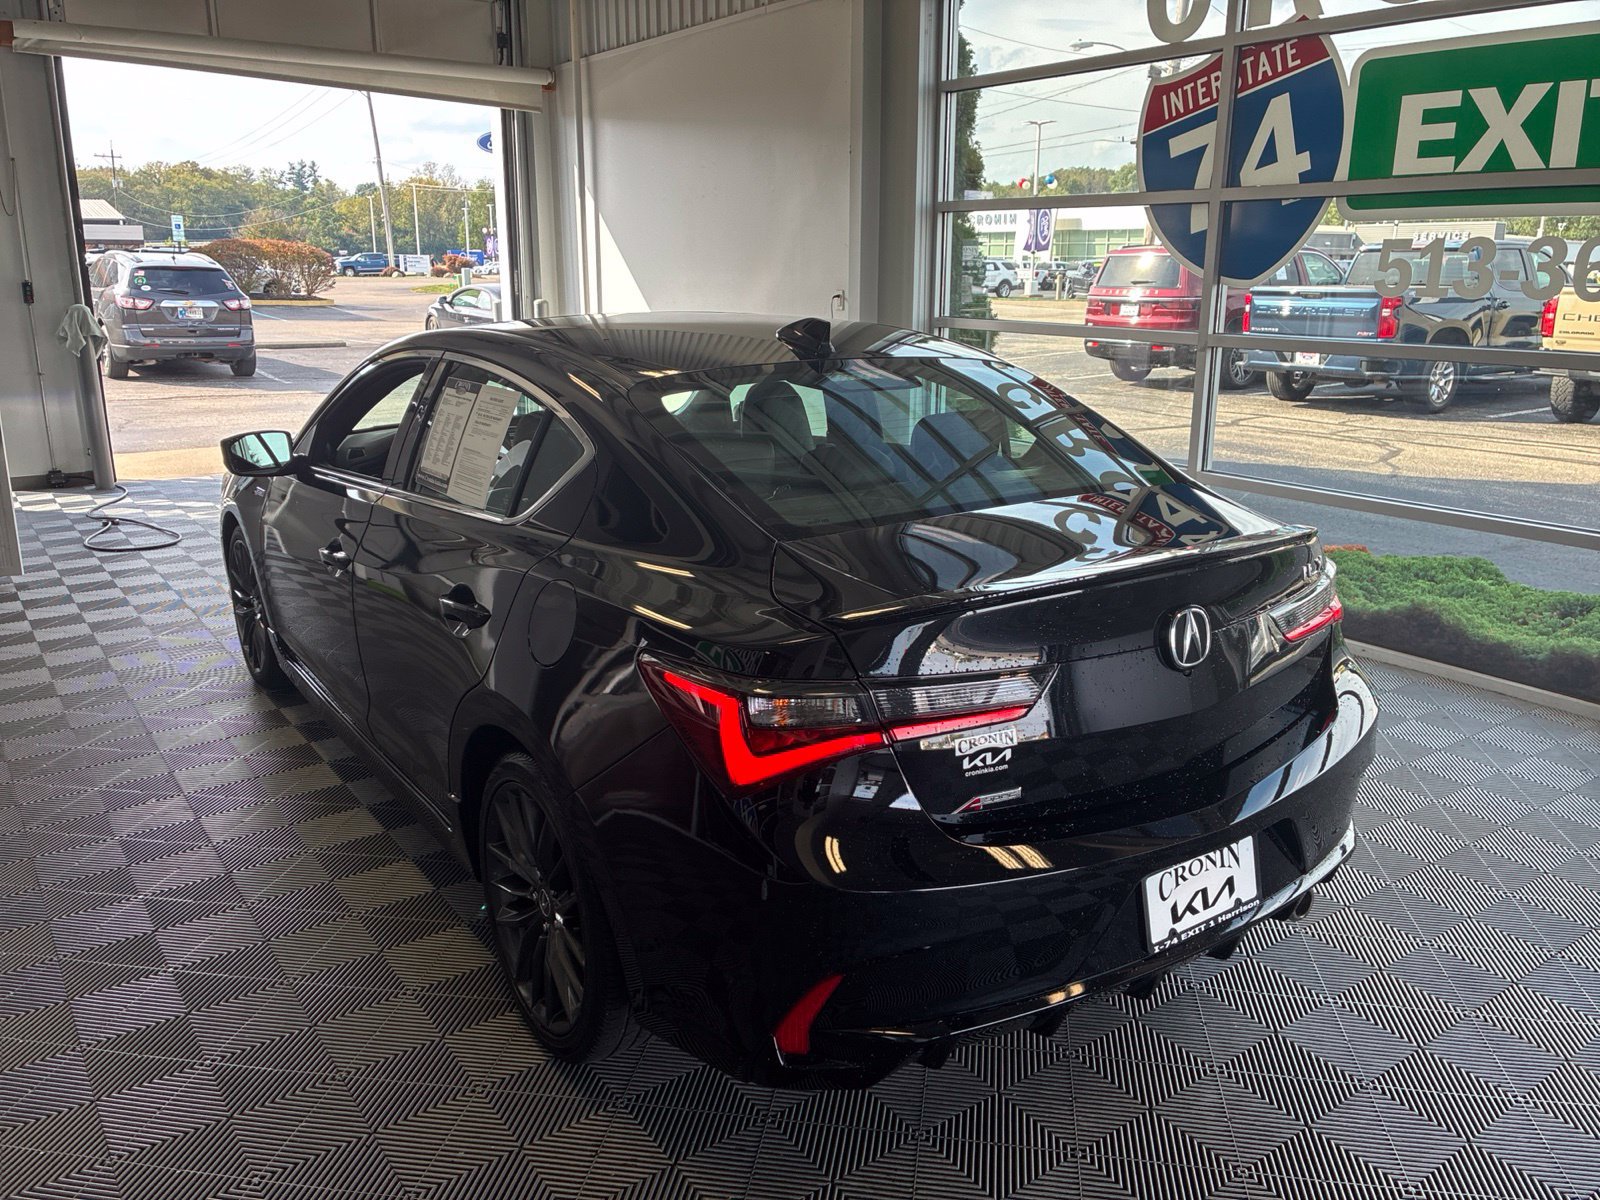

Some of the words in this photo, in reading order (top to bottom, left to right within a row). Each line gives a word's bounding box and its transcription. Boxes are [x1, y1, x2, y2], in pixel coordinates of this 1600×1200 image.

[1161, 38, 1302, 121] INTERTATE
[1393, 78, 1600, 176] EXI
[1168, 91, 1312, 235] 74
[1412, 230, 1471, 241] SERVICE
[957, 729, 1016, 754] CRONIN
[964, 764, 1009, 777] croninkia.com
[1158, 842, 1241, 902] CRONIN
[1153, 937, 1178, 953] I-74
[1181, 924, 1205, 941] EXIT
[1218, 899, 1260, 923] Harrison
